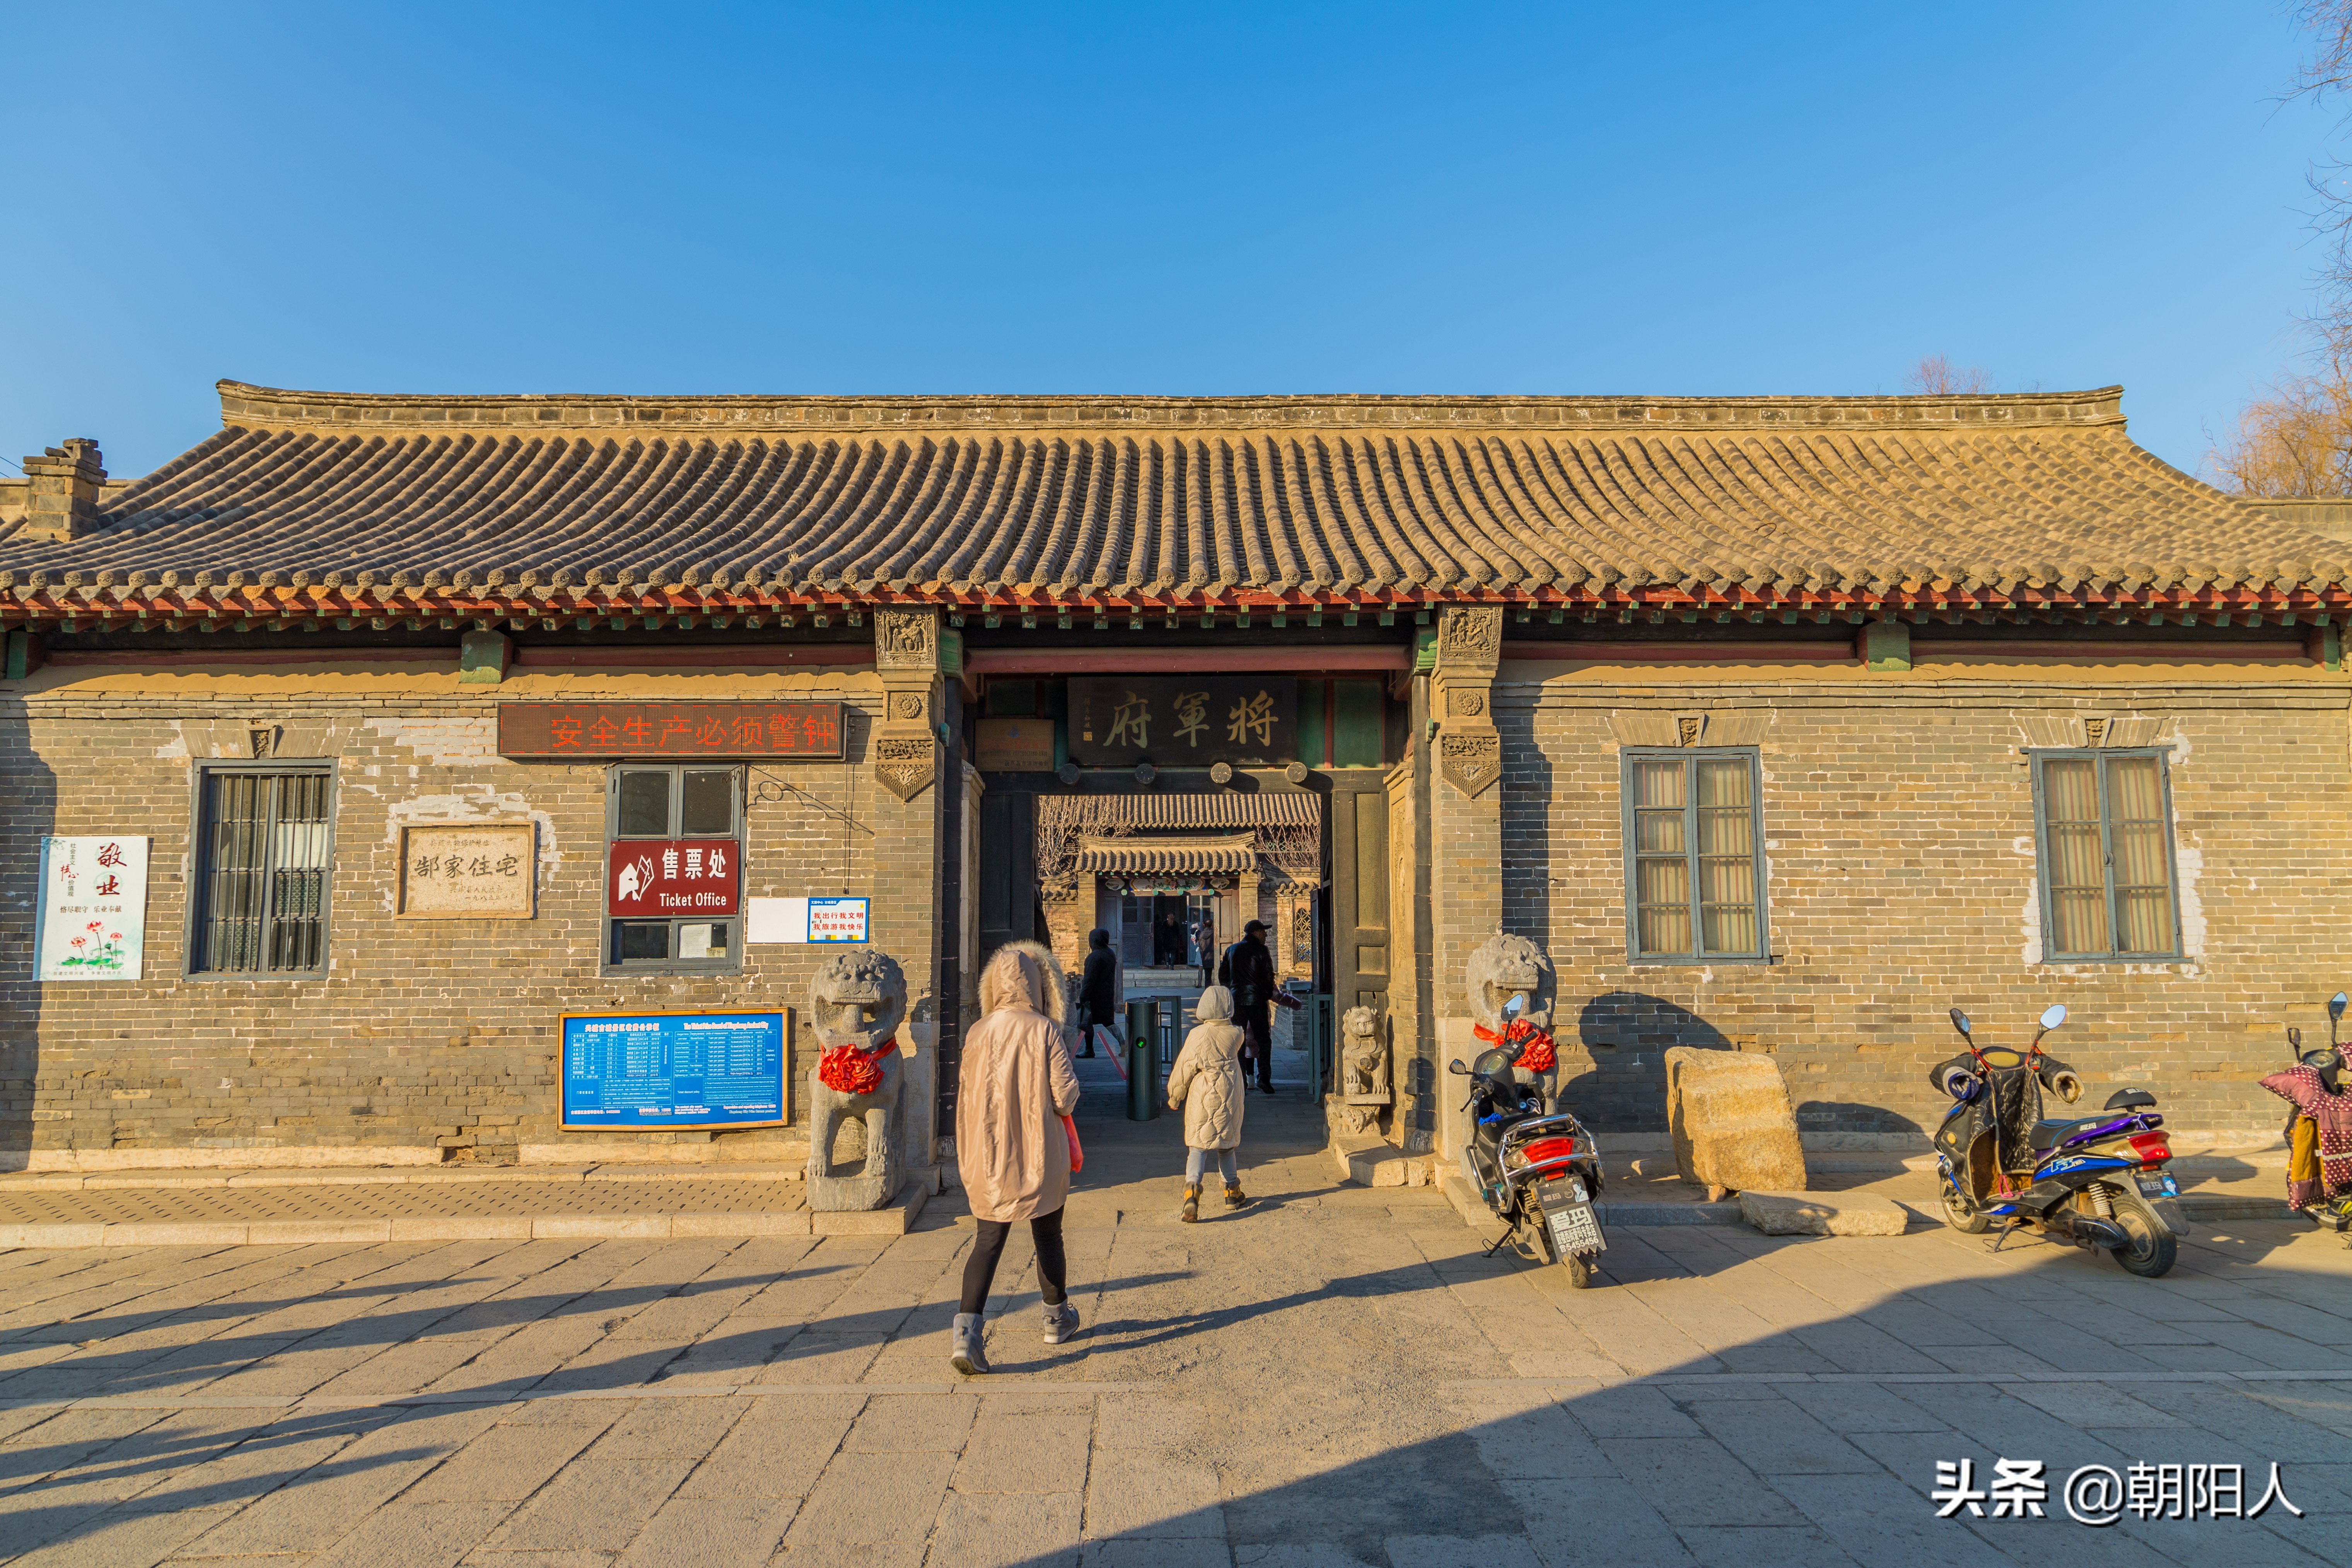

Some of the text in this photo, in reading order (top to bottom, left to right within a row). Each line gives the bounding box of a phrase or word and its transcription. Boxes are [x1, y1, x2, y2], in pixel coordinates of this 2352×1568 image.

[551, 713, 835, 749] 安全生产必须警钟
[96, 842, 127, 896] 敬业
[662, 848, 727, 879] 售票处
[659, 892, 727, 907] Ticket Office
[585, 1023, 660, 1032] 兴城古城景区收费公示板
[1566, 1236, 1599, 1251] 5455456
